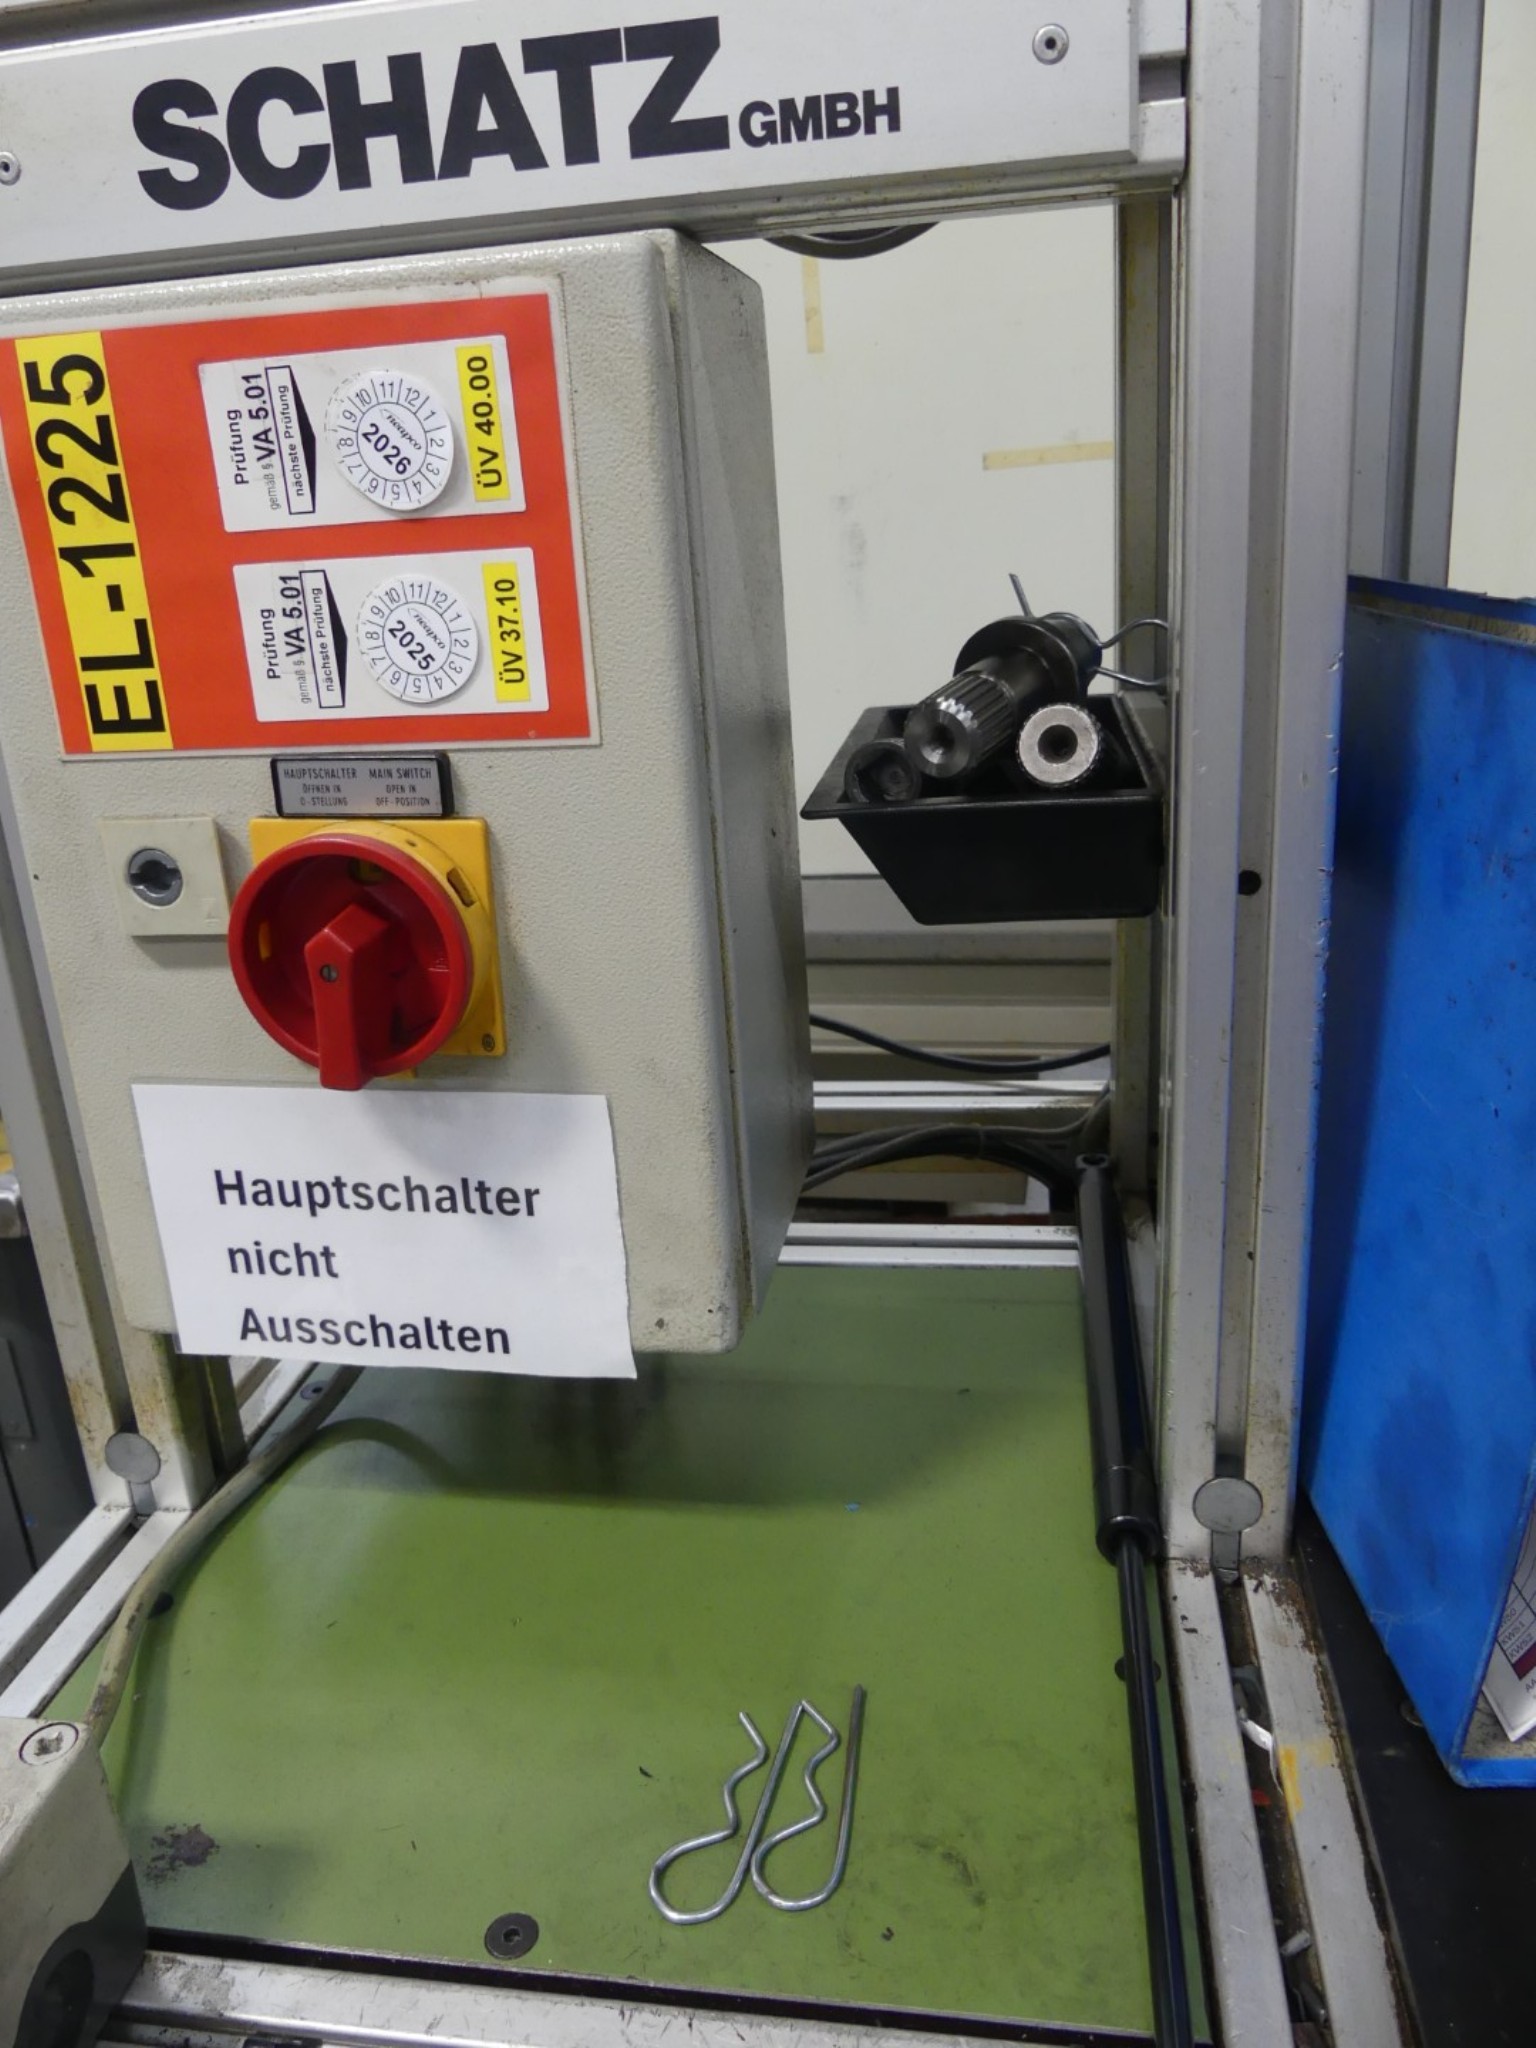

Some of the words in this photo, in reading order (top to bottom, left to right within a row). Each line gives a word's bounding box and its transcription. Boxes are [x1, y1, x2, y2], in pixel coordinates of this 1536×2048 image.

[132, 16, 730, 210] SCHATZ
[738, 86, 902, 148] GMBH
[242, 373, 270, 420] 5.01
[355, 388, 372, 406] 10
[379, 381, 395, 399] 11
[404, 387, 421, 408] 12
[467, 356, 496, 436] 40.00
[278, 385, 295, 439] Prüfung
[341, 409, 358, 424] 9
[227, 410, 249, 486] Prüfung
[253, 428, 277, 462] VA
[361, 422, 412, 475] 2026
[430, 437, 445, 448] 2
[285, 443, 304, 497] nächste
[425, 462, 440, 477] 3
[476, 446, 503, 489] ÜV
[390, 485, 400, 501] 5
[411, 480, 423, 496] 4
[24, 354, 167, 735] EL-1225
[279, 575, 303, 620] 5.01
[384, 586, 401, 605] 10
[409, 583, 423, 598] 11
[433, 590, 448, 610] 12
[311, 587, 327, 639] Prüfung
[370, 605, 385, 619] 9
[494, 578, 521, 642] 37.10
[260, 608, 281, 680] Prüfung
[284, 626, 306, 658] VA
[365, 630, 381, 641] 8
[387, 620, 436, 671] 2025
[454, 638, 469, 649] 2
[318, 642, 335, 692] nächste
[433, 675, 443, 691] 4
[449, 660, 463, 675] 3
[499, 650, 525, 684] ÜV
[412, 677, 422, 693] 5
[284, 768, 358, 780] HAUPTSCHALTER
[369, 768, 393, 780] MAIN
[396, 767, 432, 780] SWITCH
[386, 784, 406, 793] OPEN
[214, 1169, 541, 1217] Hauptschalter
[227, 1240, 339, 1278] nicht
[239, 1307, 511, 1355] Ausschalten
